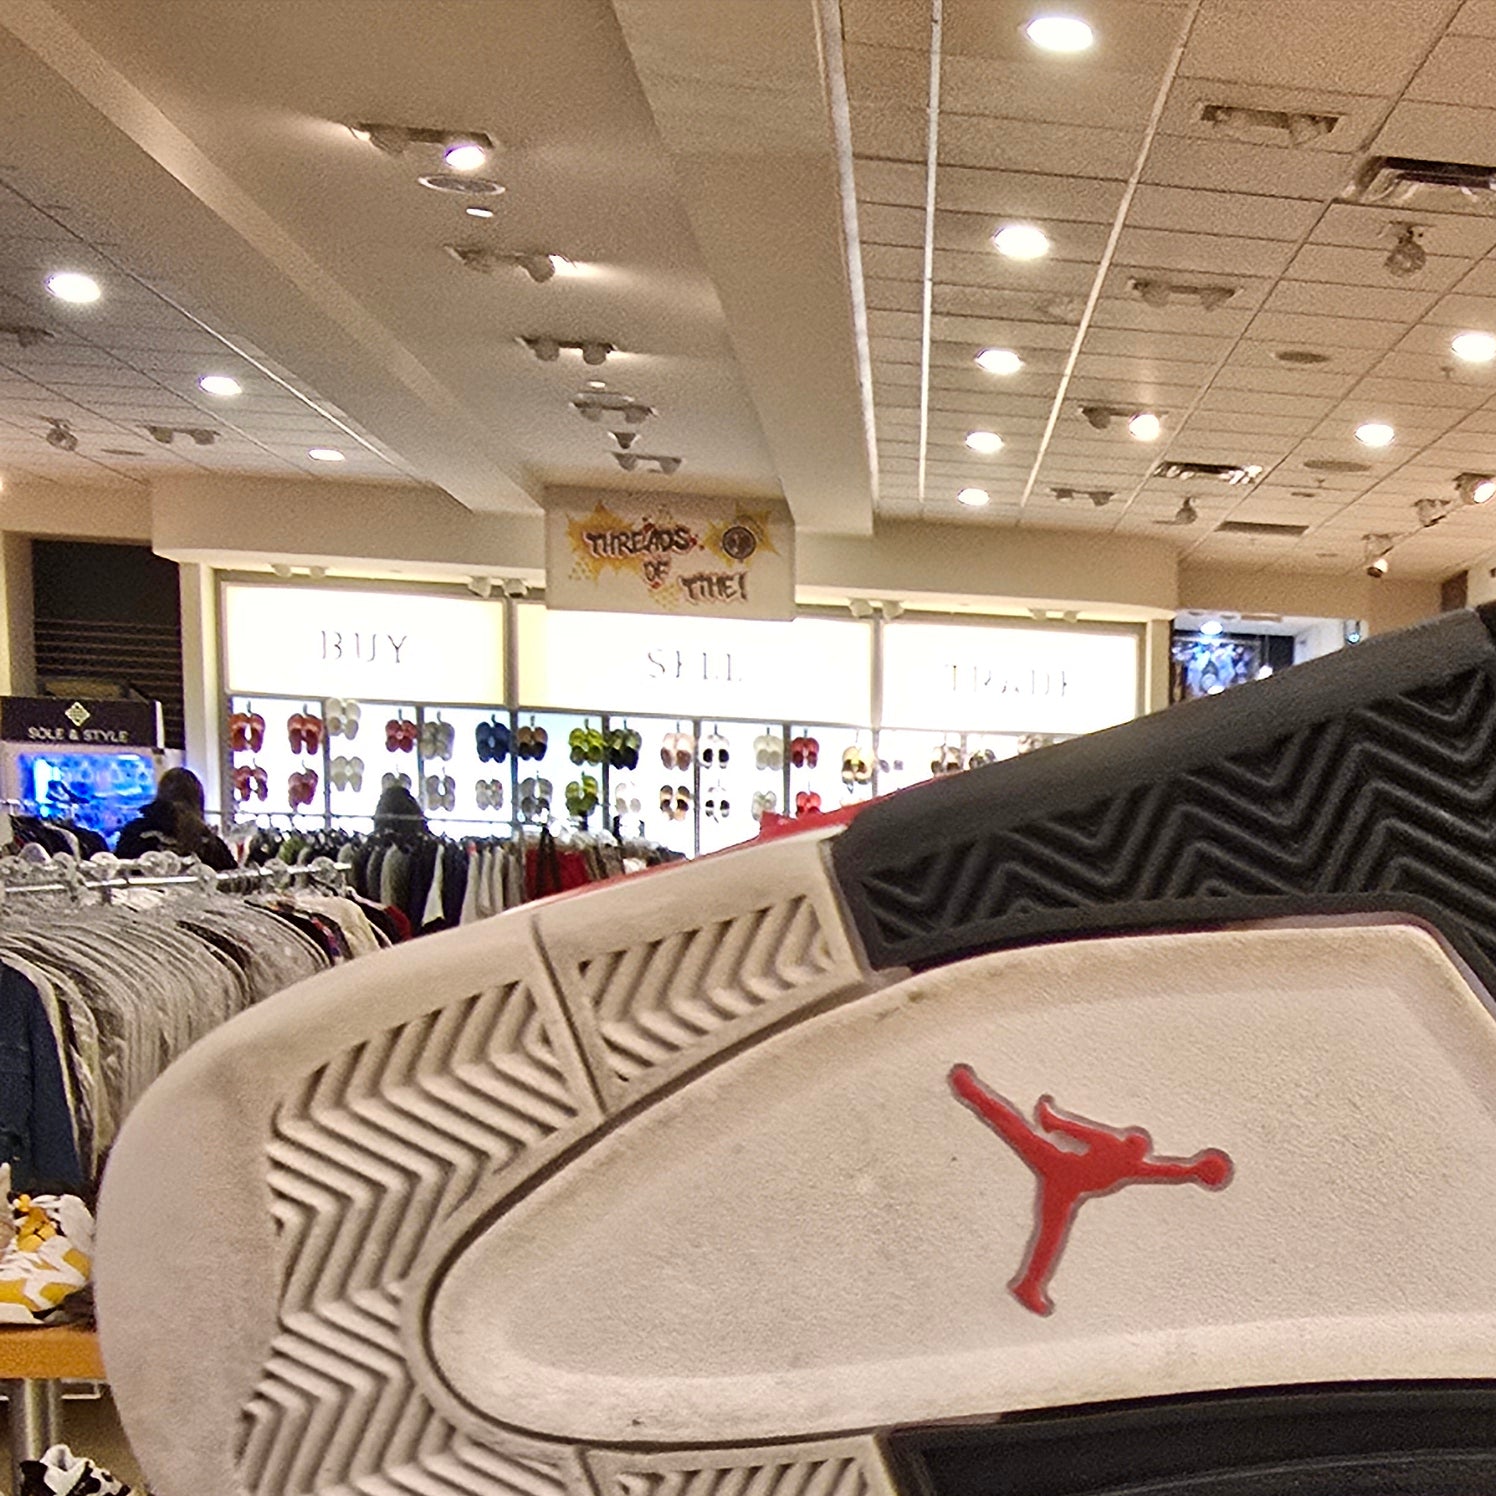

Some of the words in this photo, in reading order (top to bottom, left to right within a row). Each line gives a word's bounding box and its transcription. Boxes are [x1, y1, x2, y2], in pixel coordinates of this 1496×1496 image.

[584, 524, 692, 555] THREADS
[643, 558, 669, 583] OF
[321, 630, 408, 664] BUY
[27, 726, 65, 741] SOLE
[68, 728, 79, 742] &
[83, 729, 130, 743] STYLE
